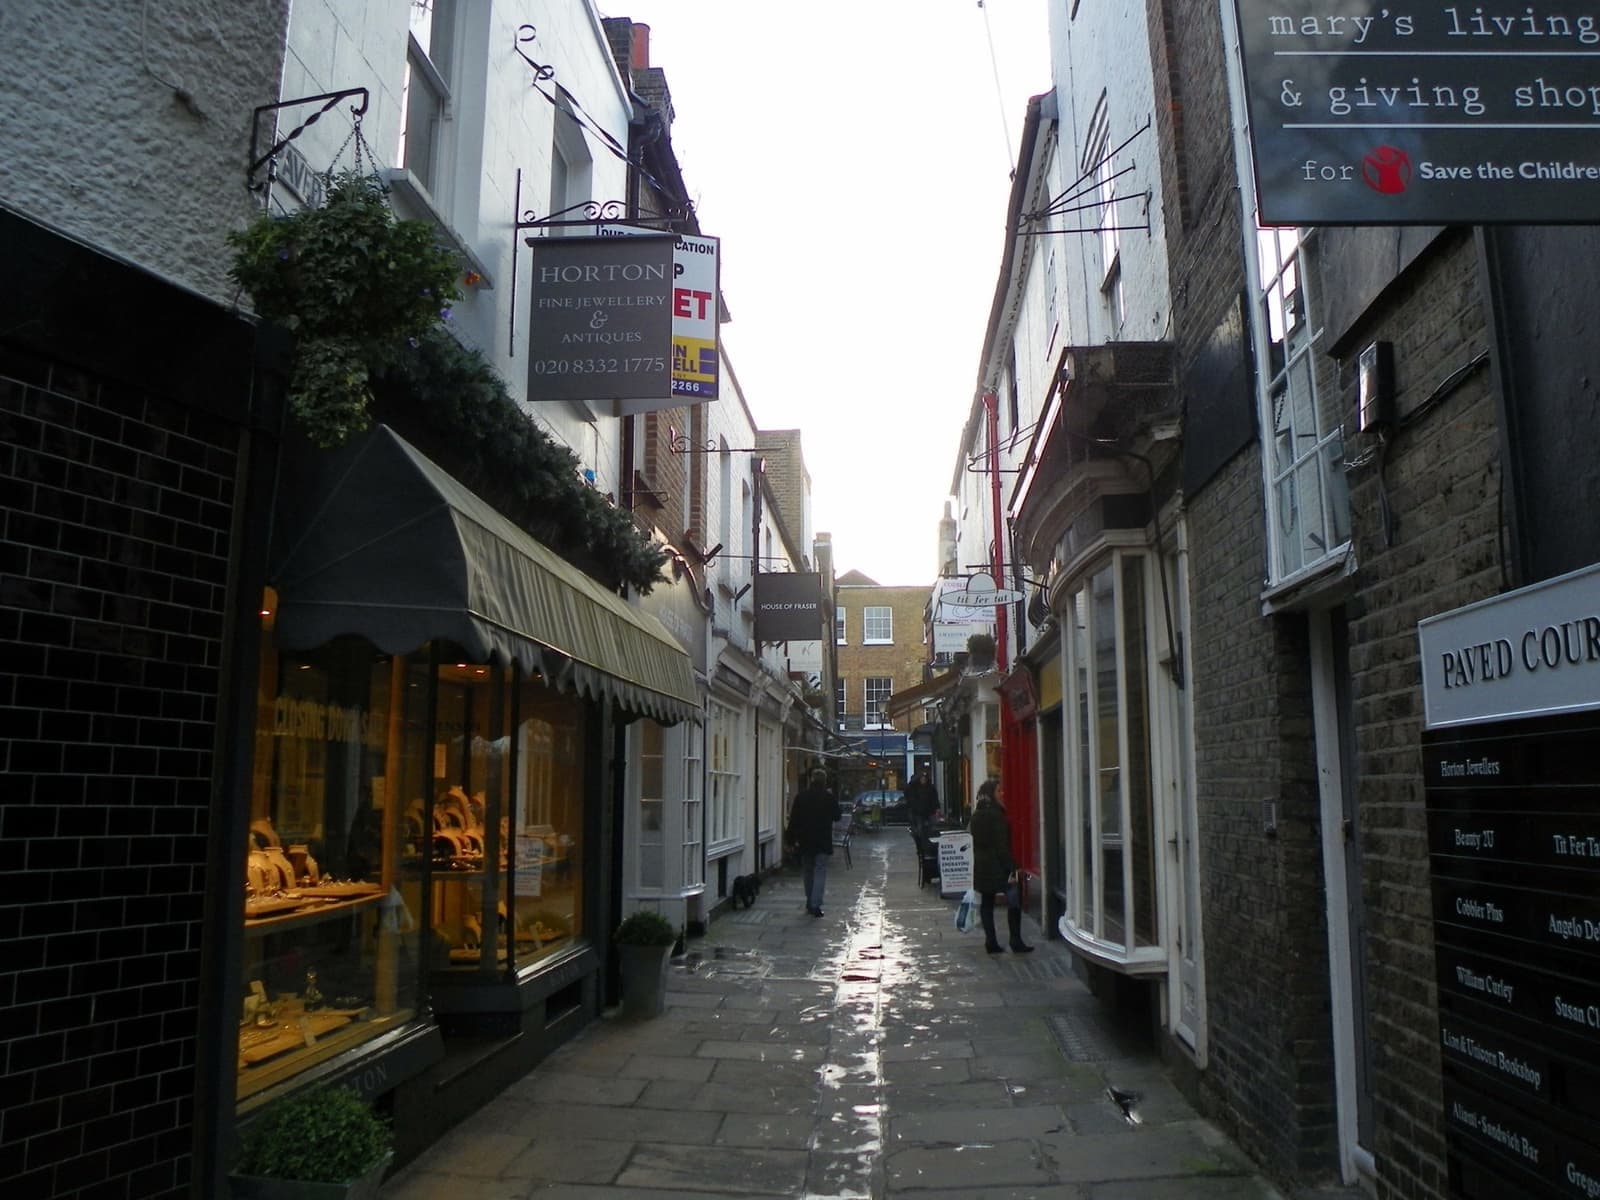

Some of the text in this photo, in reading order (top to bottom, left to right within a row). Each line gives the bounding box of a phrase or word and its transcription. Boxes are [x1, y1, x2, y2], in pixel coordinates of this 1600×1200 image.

[1445, 7, 1600, 45] living
[1280, 79, 1303, 108] &
[1328, 77, 1486, 116] giving
[1301, 159, 1600, 182] for Save the Childre
[540, 263, 667, 283] HORTON
[538, 295, 667, 310] FINE JEWELLERY
[589, 310, 609, 329] &
[561, 331, 643, 346] ANTIQUES
[534, 356, 666, 375] 020 8332 1775
[794, 602, 817, 610] FRASER
[1441, 637, 1513, 690] PAVED
[1569, 835, 1586, 857] Fer
[1586, 836, 1600, 858] Ta
[1455, 897, 1486, 919] Cobbler
[1548, 913, 1583, 940] Angelo
[1555, 996, 1585, 1024] Susan
[1498, 1050, 1541, 1091] Bookshop
[1481, 1118, 1520, 1153] Sandwich
